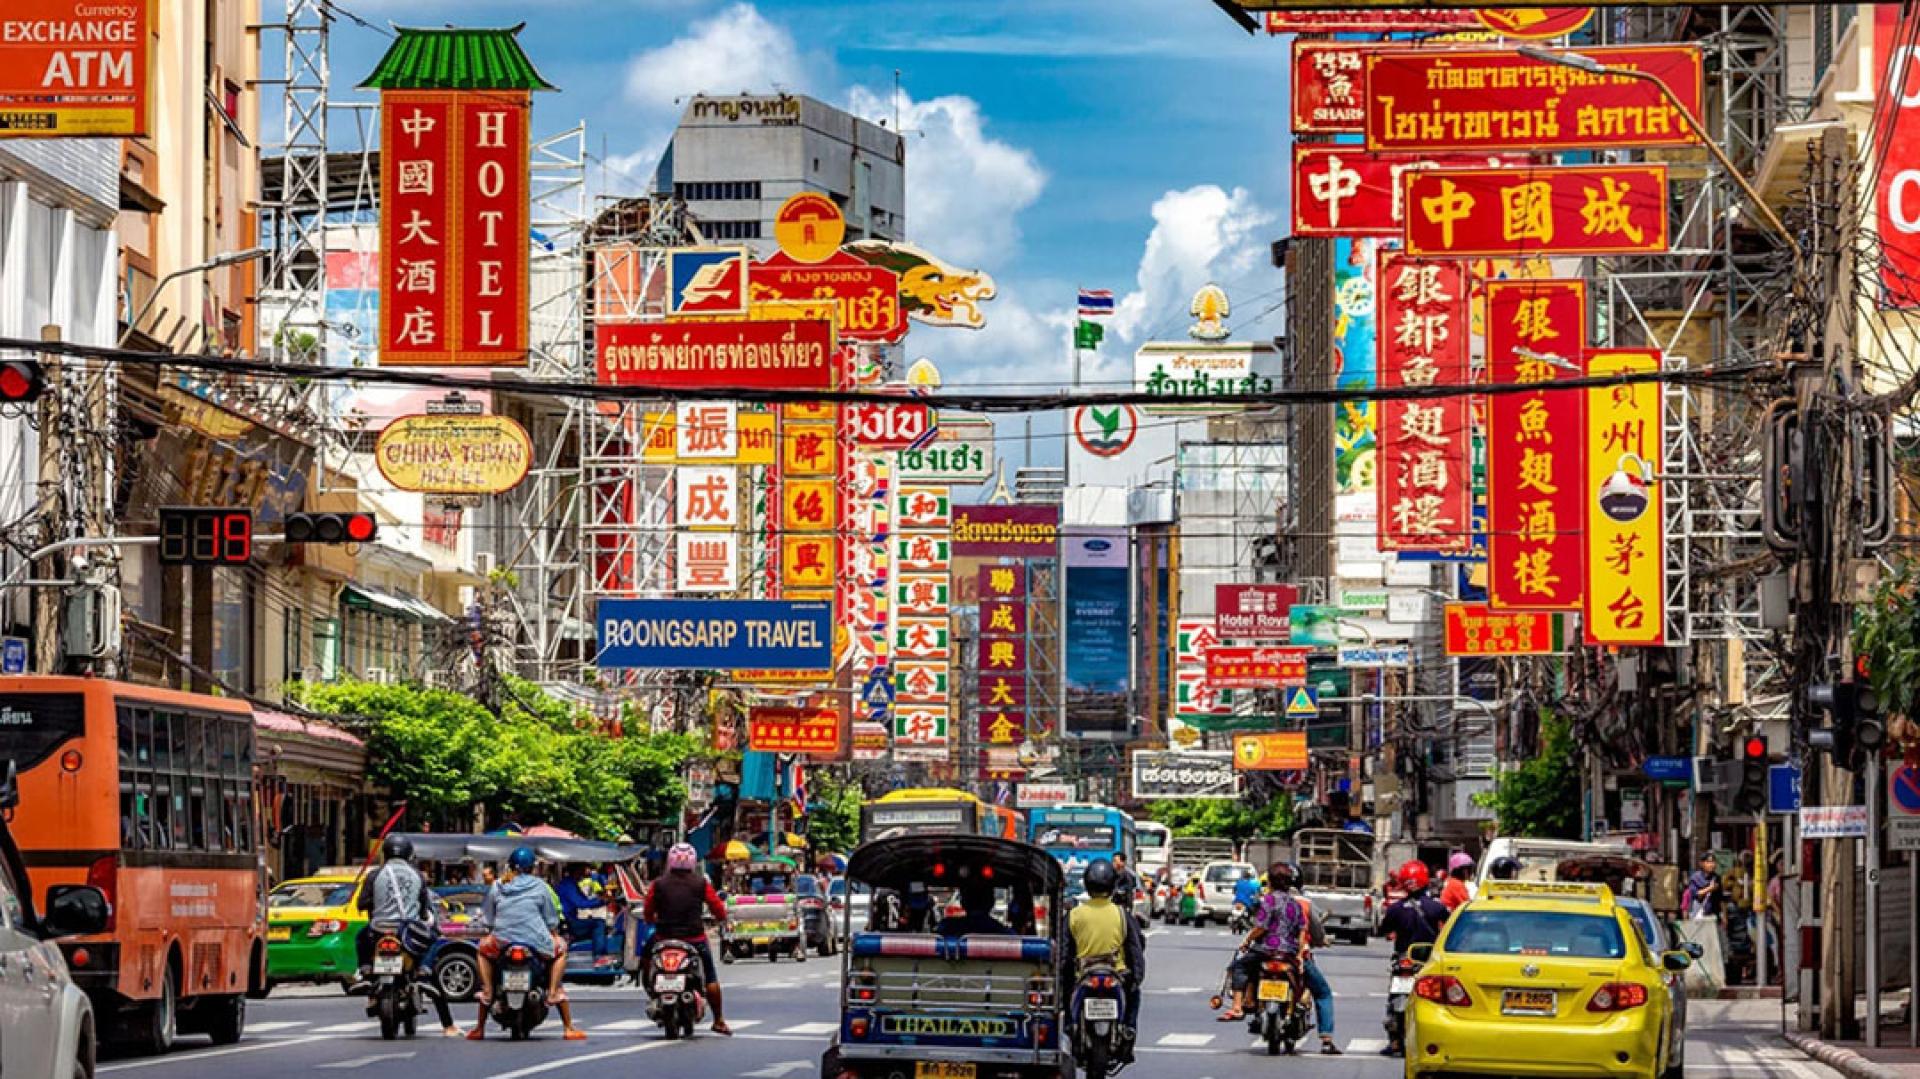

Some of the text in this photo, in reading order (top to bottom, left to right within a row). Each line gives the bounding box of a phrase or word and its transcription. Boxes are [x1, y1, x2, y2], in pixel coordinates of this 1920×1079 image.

[3, 21, 136, 41] EXCHANGE
[75, 4, 137, 18] Currency
[41, 51, 133, 87] ATM
[396, 108, 440, 346] 中國大酒店
[477, 112, 508, 346] HOTEL
[1422, 176, 1643, 249] 中國城
[1391, 265, 1456, 537] 銀都魚翅酒樓
[385, 442, 453, 463] CHINA
[1512, 297, 1560, 597] 銀都魚翅酒樓
[685, 406, 729, 587] 振成豐
[212, 514, 250, 560] 19
[605, 620, 823, 648] ROONGSARP TRAVEL
[907, 492, 936, 740] 和成興大金行
[1219, 614, 1253, 627] Hotel
[895, 1019, 1007, 1034] THAILAND
